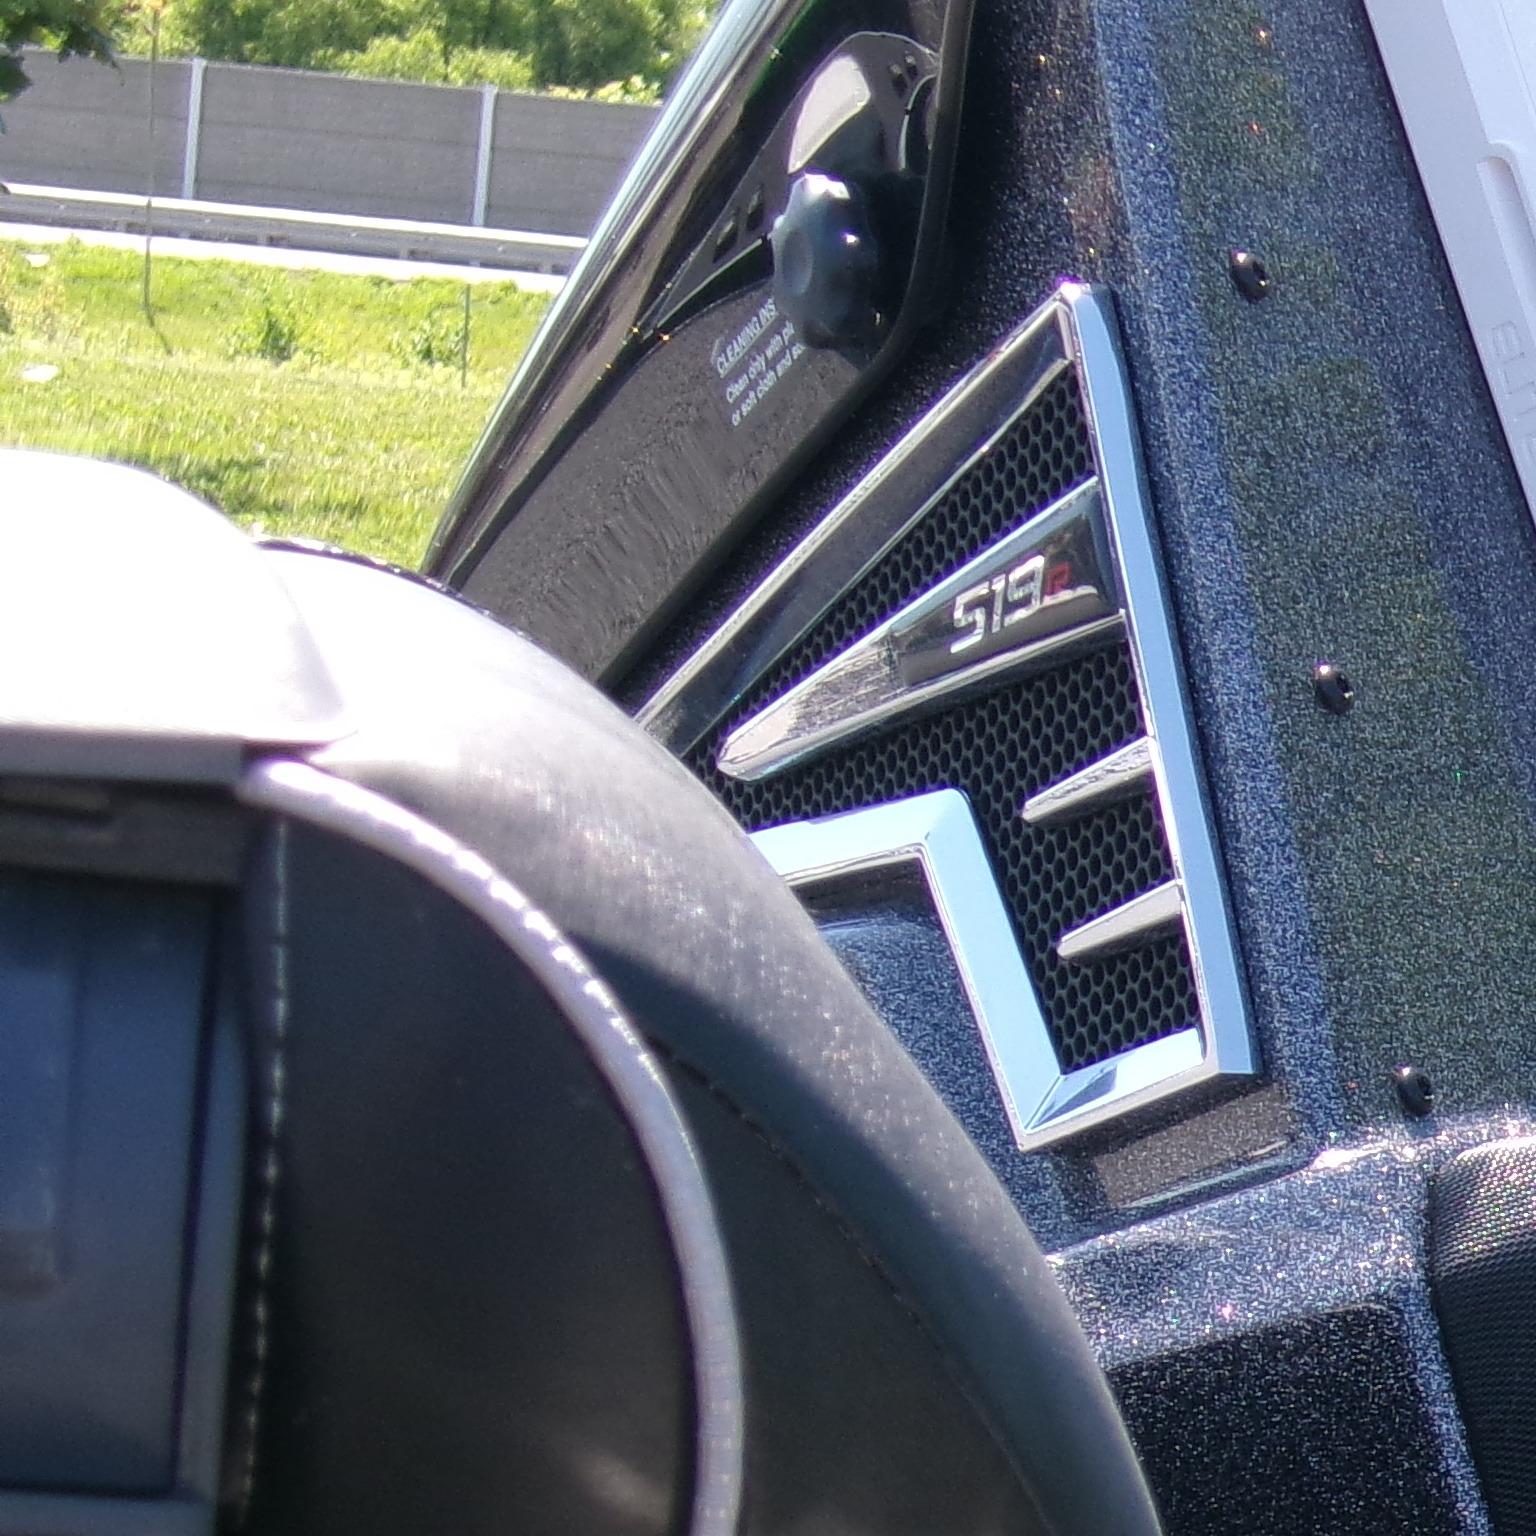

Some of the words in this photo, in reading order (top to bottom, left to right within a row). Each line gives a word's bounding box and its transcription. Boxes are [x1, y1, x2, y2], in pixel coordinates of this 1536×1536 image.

[717, 316, 761, 375] CLEANING
[726, 373, 749, 403] Clean
[765, 334, 783, 360] with
